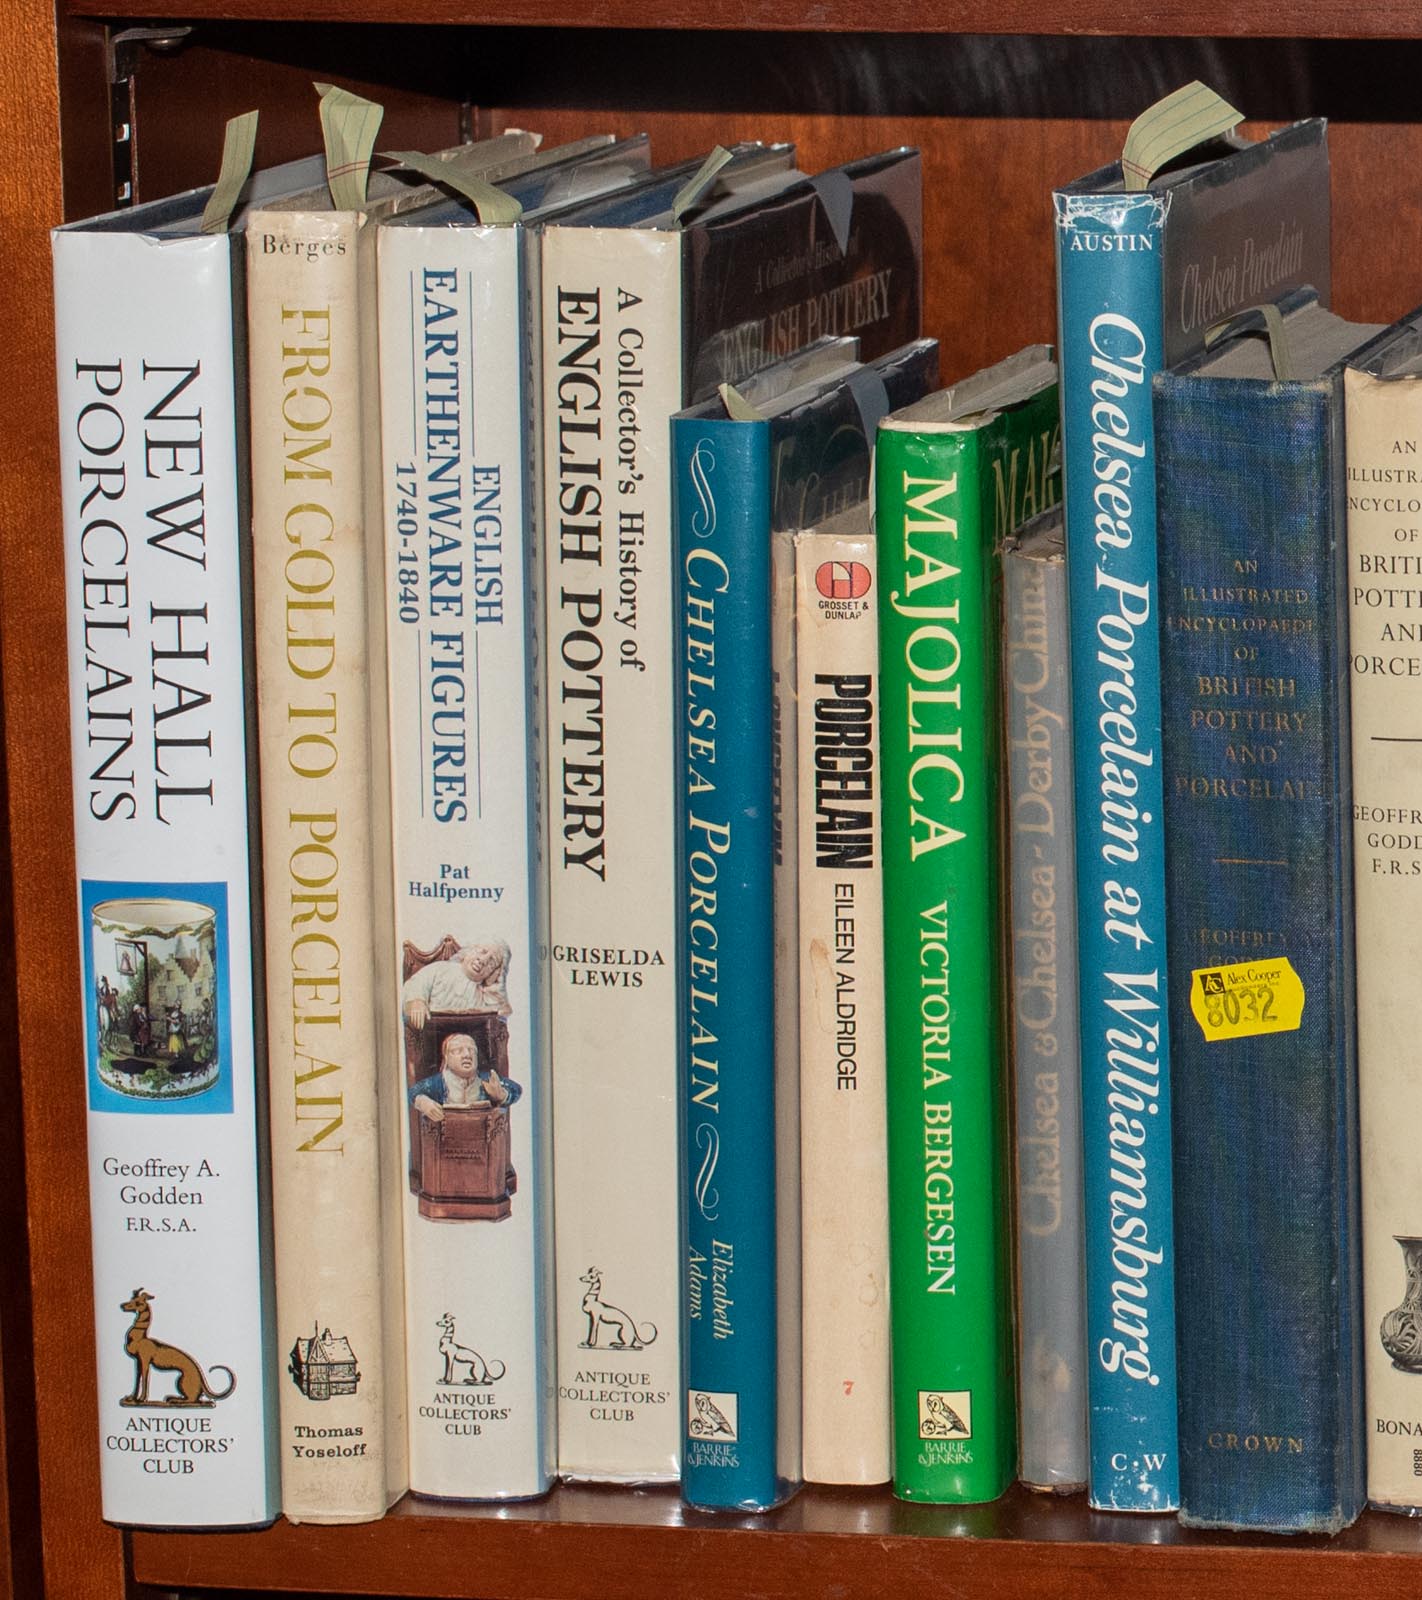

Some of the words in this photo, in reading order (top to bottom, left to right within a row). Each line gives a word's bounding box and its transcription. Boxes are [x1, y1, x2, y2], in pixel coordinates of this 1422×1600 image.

[262, 233, 347, 263] Berges
[618, 289, 643, 311] A
[1071, 233, 1153, 252] AUSTIN
[142, 359, 207, 571] NEW
[280, 305, 333, 485] FROM
[424, 266, 464, 618] EARTHENWARE
[556, 285, 602, 566] ENGLISH
[617, 329, 644, 495] Collector's
[1088, 312, 1143, 556] Chelsea
[75, 359, 136, 821] PORCELAINS
[283, 504, 335, 680] GOLD
[395, 462, 420, 624] 1740-1840
[472, 465, 503, 625] ENGLISH
[613, 510, 644, 627] History
[150, 603, 214, 824] HALL
[431, 631, 468, 824] FIGURES
[560, 587, 606, 880] POTTERY
[619, 639, 645, 669] of
[686, 549, 730, 794] CHELSEA
[890, 471, 966, 861] MAJOLICA
[1095, 564, 1155, 860] Porcelain
[287, 693, 338, 781] TO
[814, 674, 874, 868] PORCELAIN
[409, 881, 504, 903] Halfpenny
[440, 864, 470, 880] Pat
[834, 883, 853, 962] EILEEN
[1105, 880, 1157, 946] at
[288, 810, 344, 1156] PORCELAIN
[688, 810, 730, 1112] PORCELAIN
[836, 971, 857, 1091] ALDRIDGE
[920, 901, 952, 1091] VICTORIA
[1205, 987, 1278, 1027] 8032
[103, 1157, 189, 1181] Geoffrey
[196, 1159, 220, 1178] A.
[120, 1185, 203, 1206] Godden
[924, 1100, 956, 1294] BERGESEN
[1099, 966, 1162, 1385] Williamsburg
[688, 1248, 703, 1319] Adams
[711, 1239, 736, 1339] Elizabeth
[292, 1443, 366, 1460] Yoseloff
[295, 1424, 364, 1440] Thomas
[1209, 1433, 1303, 1453] CROWN
